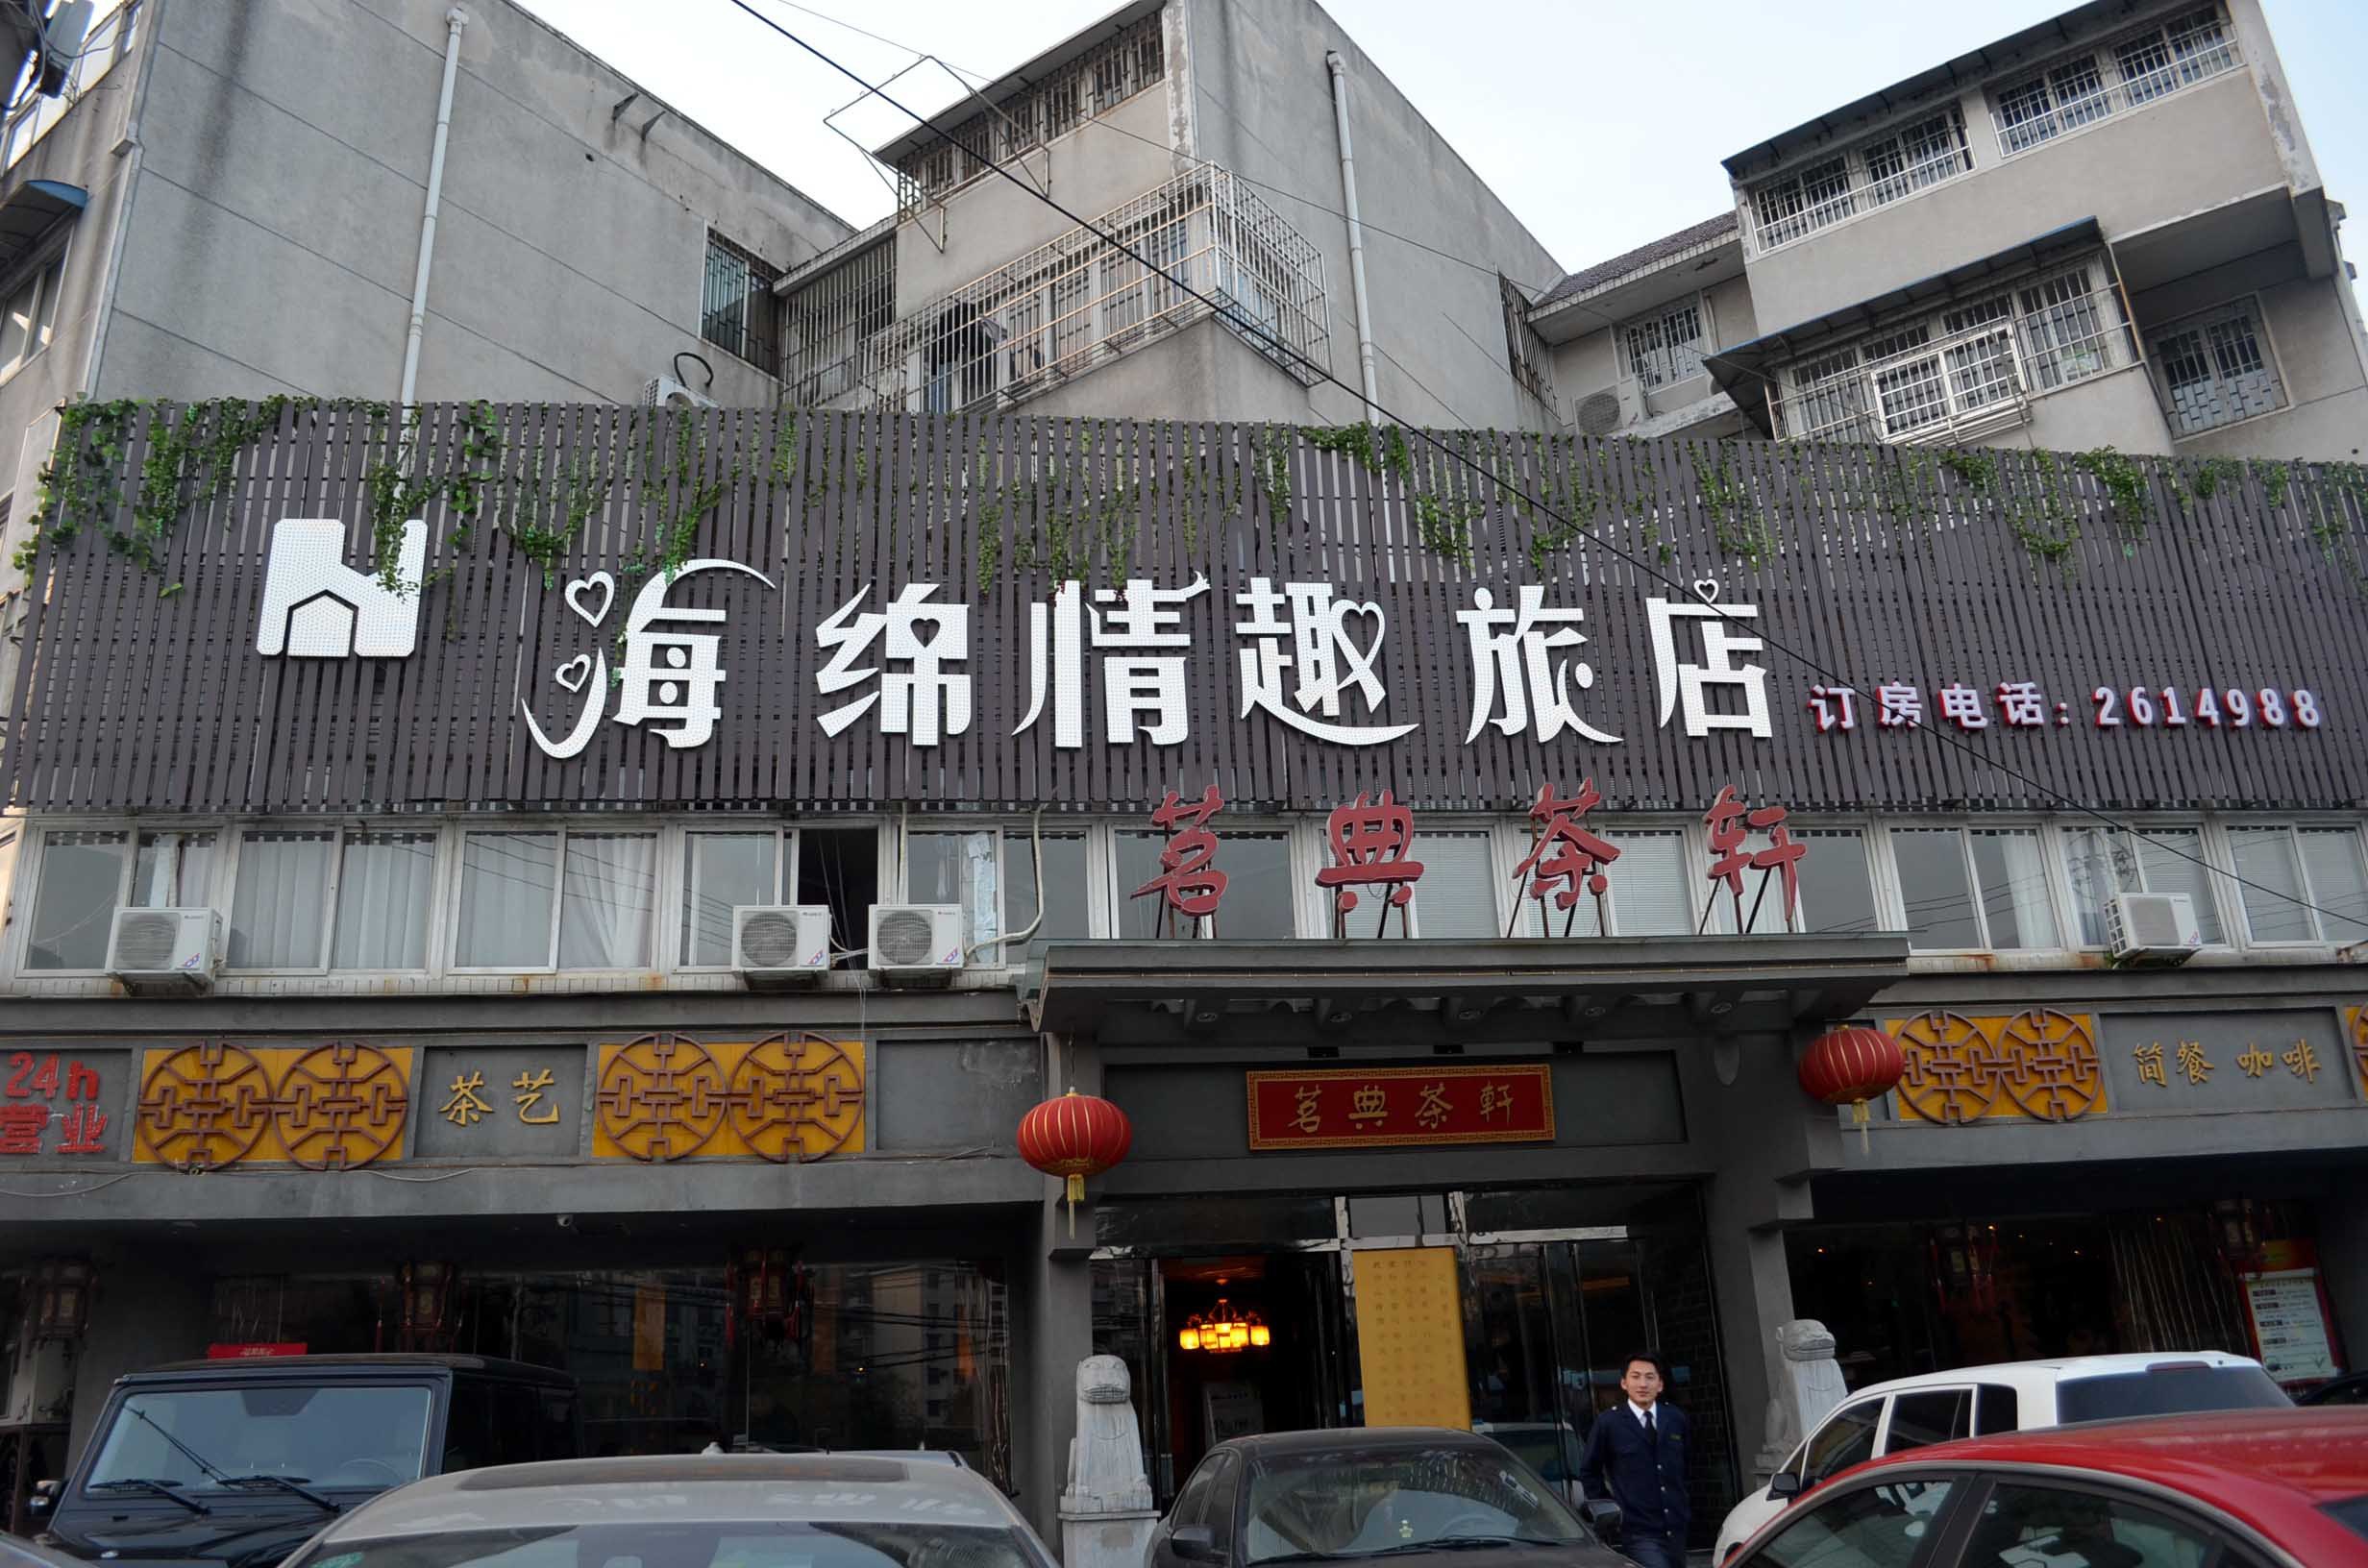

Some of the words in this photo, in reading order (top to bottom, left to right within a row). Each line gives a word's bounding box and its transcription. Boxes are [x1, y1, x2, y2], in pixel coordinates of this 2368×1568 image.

[521, 558, 1773, 760] 海绵情趣旅店
[6, 1051, 101, 1100] 24h
[437, 1067, 561, 1127] 茶艺
[0, 1102, 108, 1154] 营业
